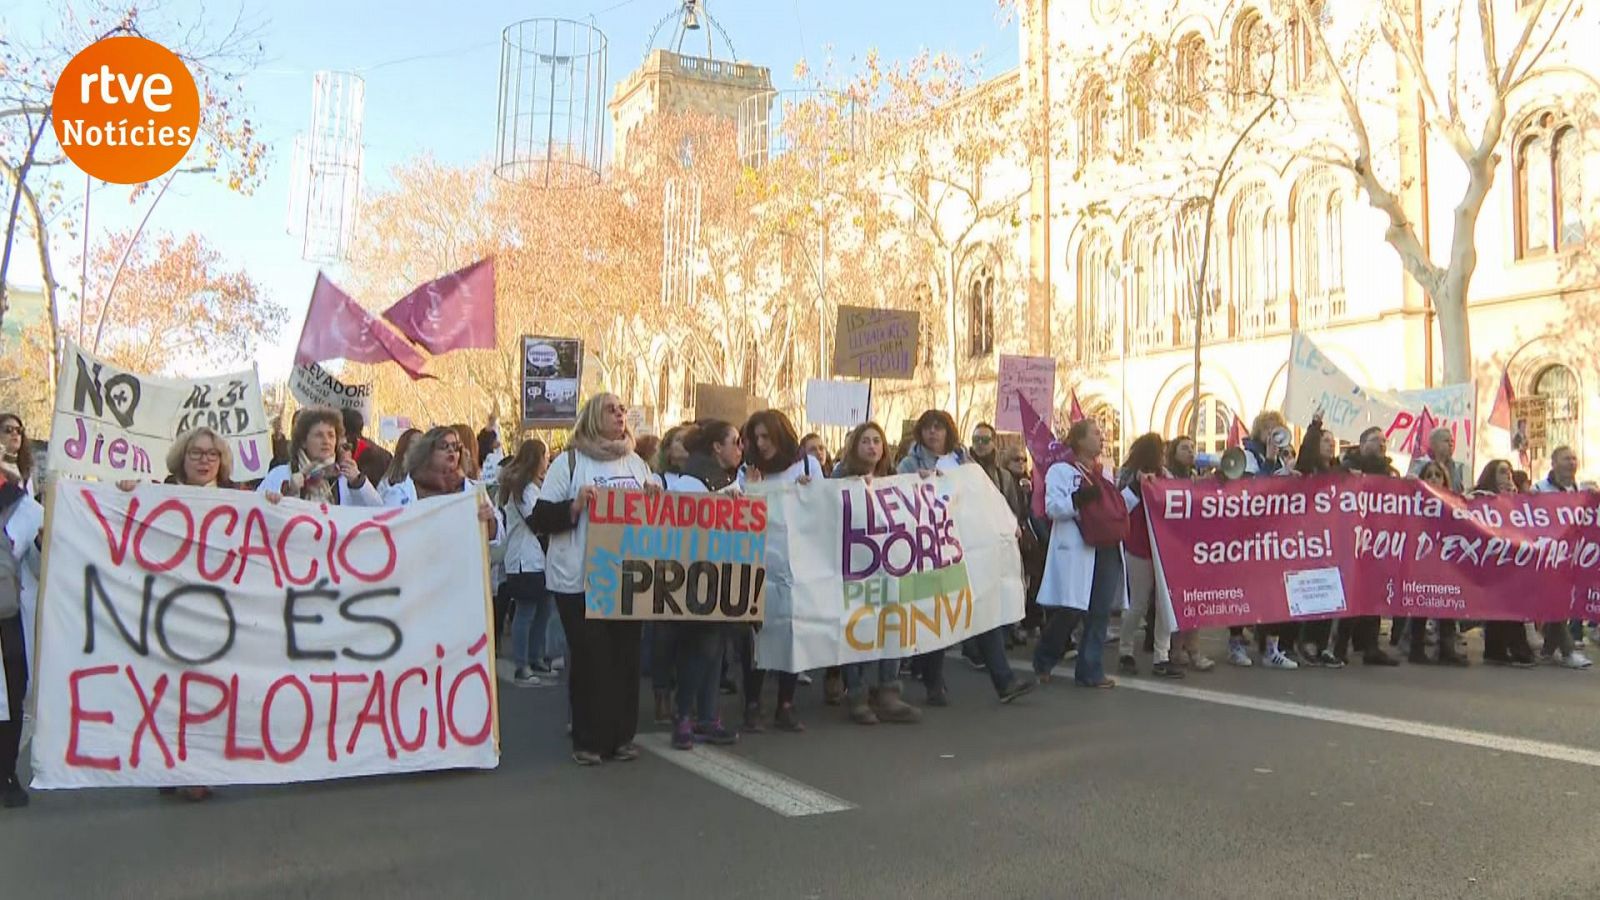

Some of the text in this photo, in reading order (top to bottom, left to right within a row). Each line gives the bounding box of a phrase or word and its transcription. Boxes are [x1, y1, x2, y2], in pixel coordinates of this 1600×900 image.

[74, 354, 141, 428] NO
[64, 418, 152, 474] diem
[1384, 411, 1471, 460] PRU!
[588, 491, 767, 533] LLEVADORES
[1164, 489, 1192, 520] El
[1201, 489, 1306, 518] sistema
[1509, 503, 1551, 528] els
[81, 489, 402, 587] VOCACIÓ
[619, 526, 684, 562] AQUI
[1193, 529, 1333, 565] sacrificis!
[1415, 530, 1600, 572] D'EXPLOTAR-NO
[621, 559, 765, 617] PROU!
[843, 578, 888, 610] PEL
[1183, 587, 1244, 602] Infermeres
[1183, 601, 1250, 618] de Catalunya
[1402, 581, 1461, 595] Infermeres
[1402, 594, 1465, 609] de Catalunya
[84, 564, 402, 665] NO ÉS
[845, 586, 973, 651] CANVI
[65, 632, 492, 772] EXPLOTACIÓ
